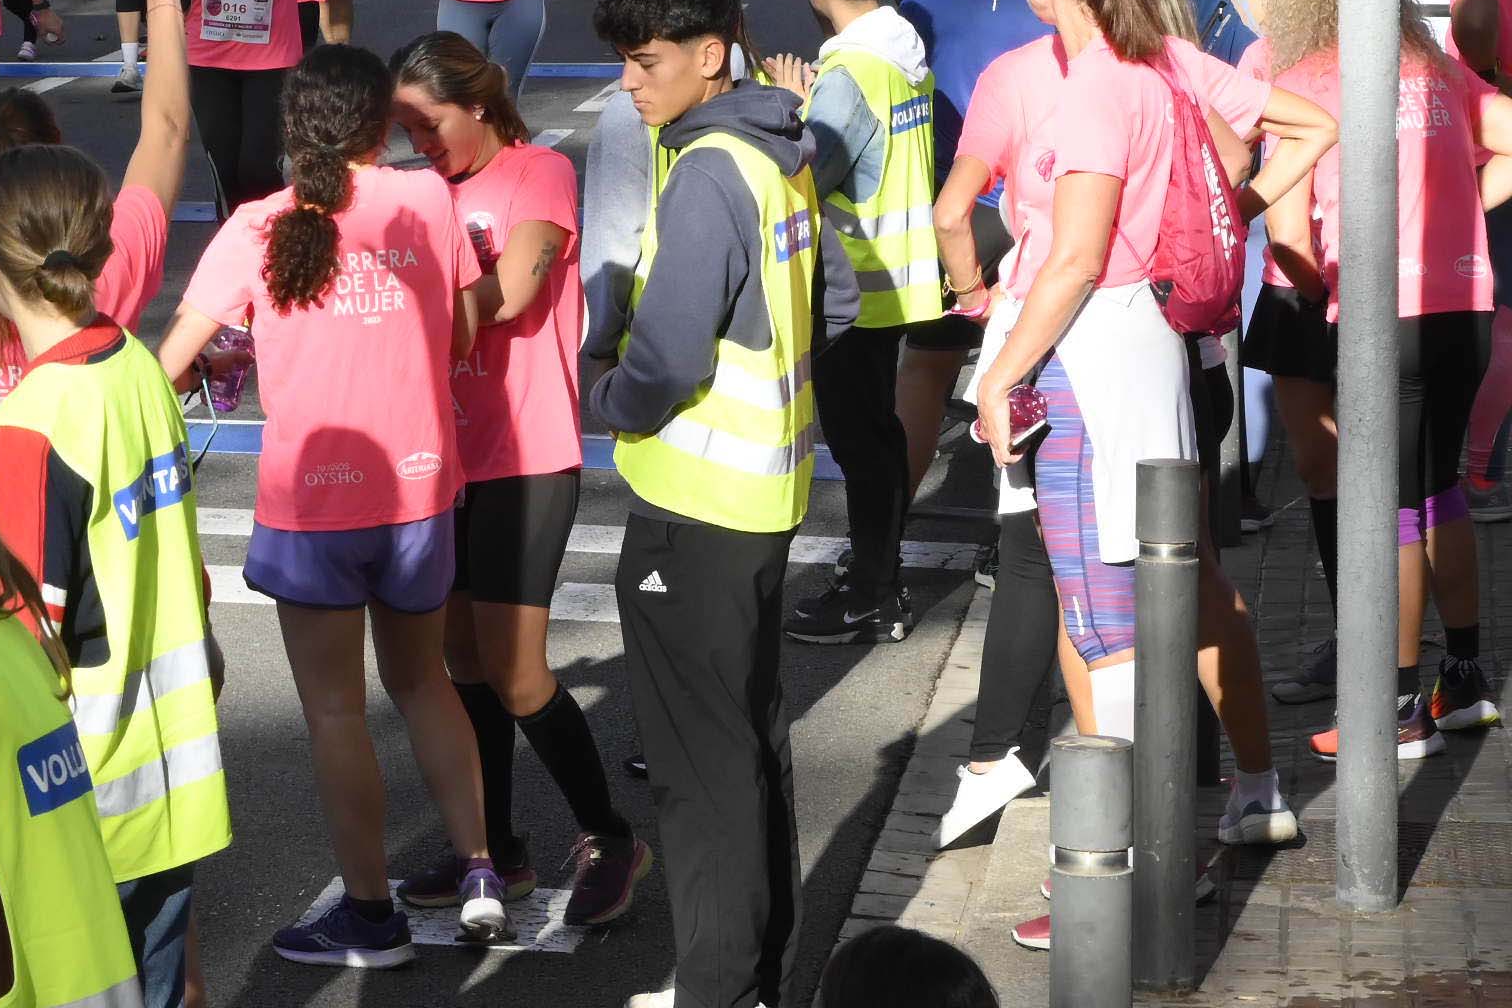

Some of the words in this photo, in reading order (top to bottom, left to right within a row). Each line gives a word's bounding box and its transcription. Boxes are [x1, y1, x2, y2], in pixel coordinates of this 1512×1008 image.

[223, 2, 247, 13] 016
[1399, 77, 1449, 92] RRERA
[1424, 94, 1444, 109] LA
[1398, 110, 1453, 130] MUJER
[335, 248, 419, 269] ARRERA
[336, 274, 368, 296] DE
[374, 273, 402, 291] LA
[333, 290, 407, 317] MUJER
[304, 470, 364, 486] OYSHO
[639, 584, 667, 592] adidas
[27, 742, 87, 792] VOLU
